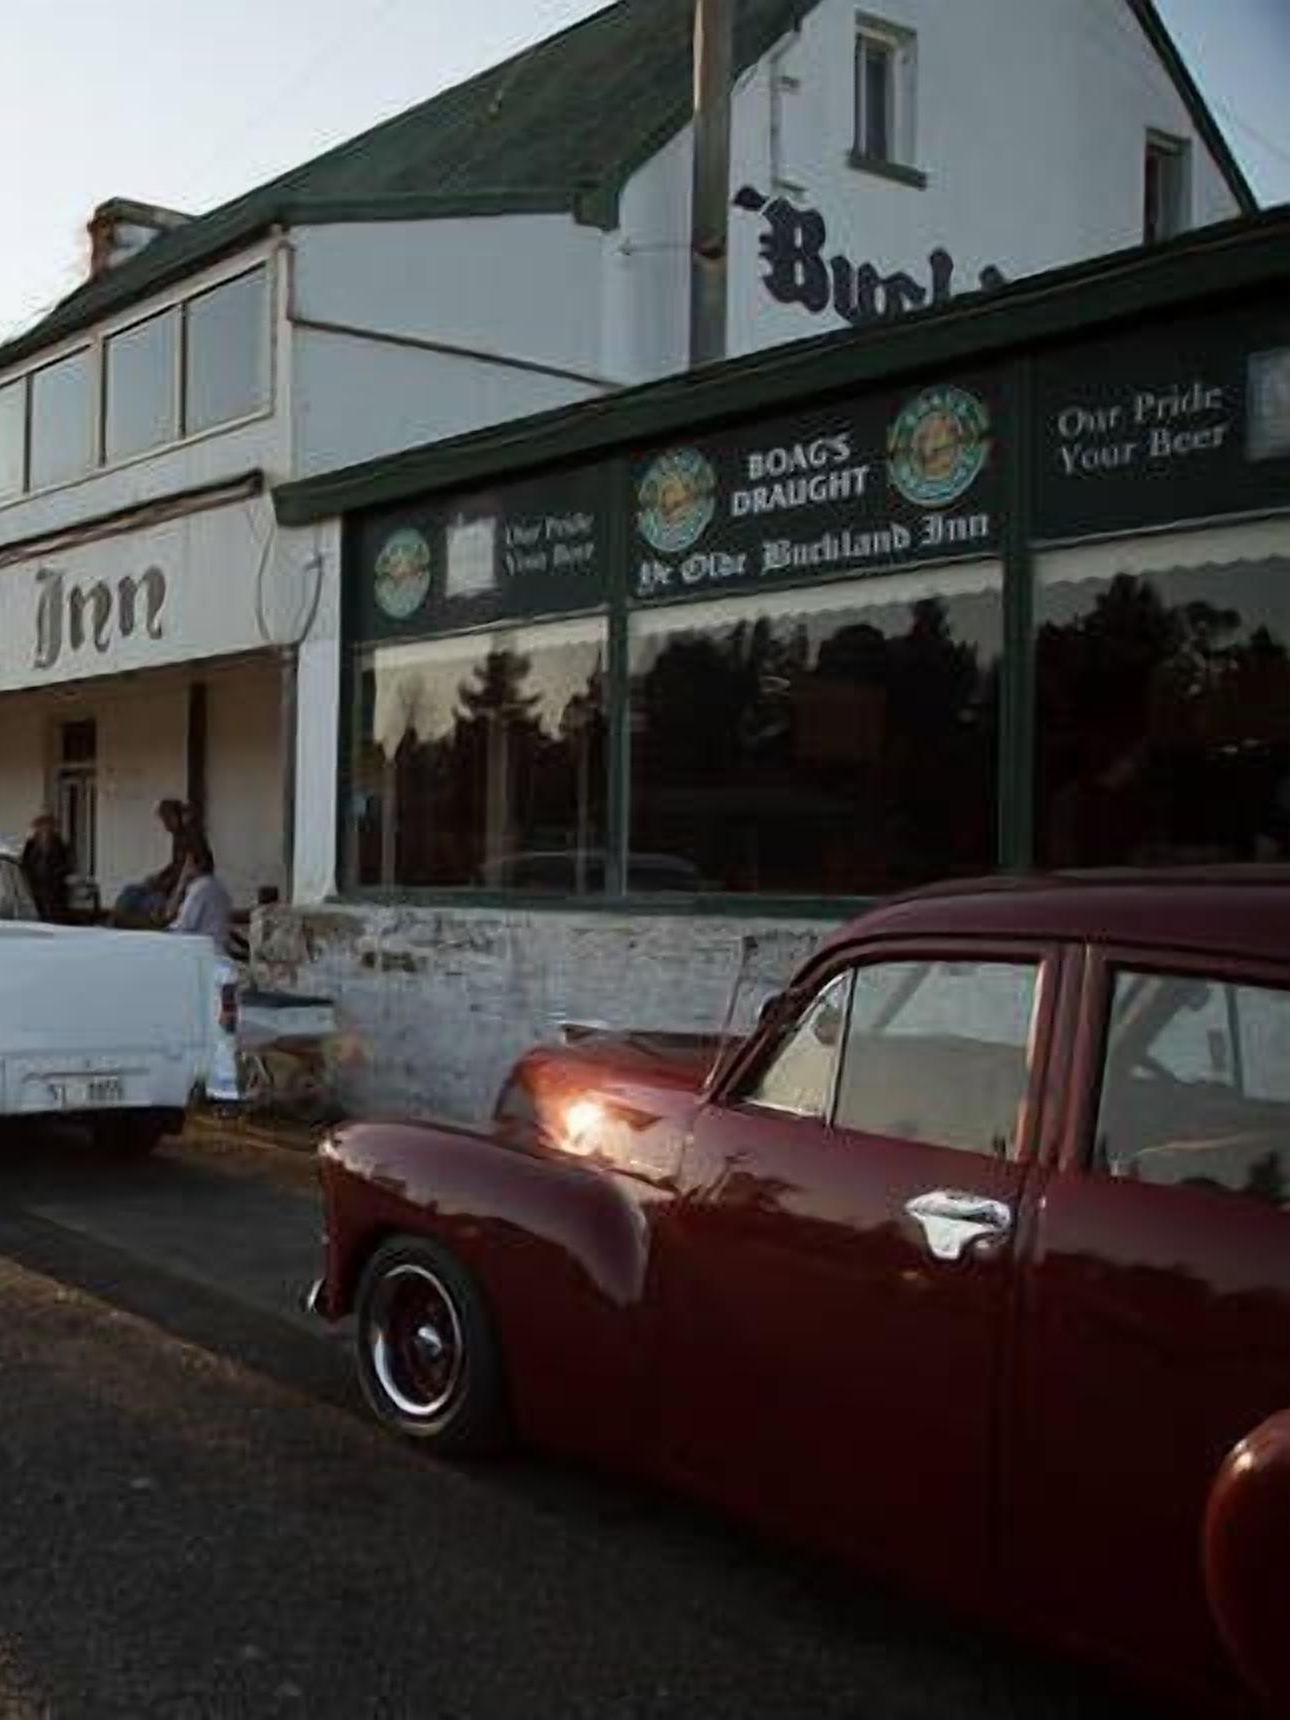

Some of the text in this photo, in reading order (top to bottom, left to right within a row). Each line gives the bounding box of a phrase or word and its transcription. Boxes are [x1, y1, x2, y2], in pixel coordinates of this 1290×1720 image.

[1061, 442, 1136, 475] Your
[732, 465, 870, 516] DRAUGHT
[920, 514, 990, 546] Inn
[33, 564, 168, 670] Inn
